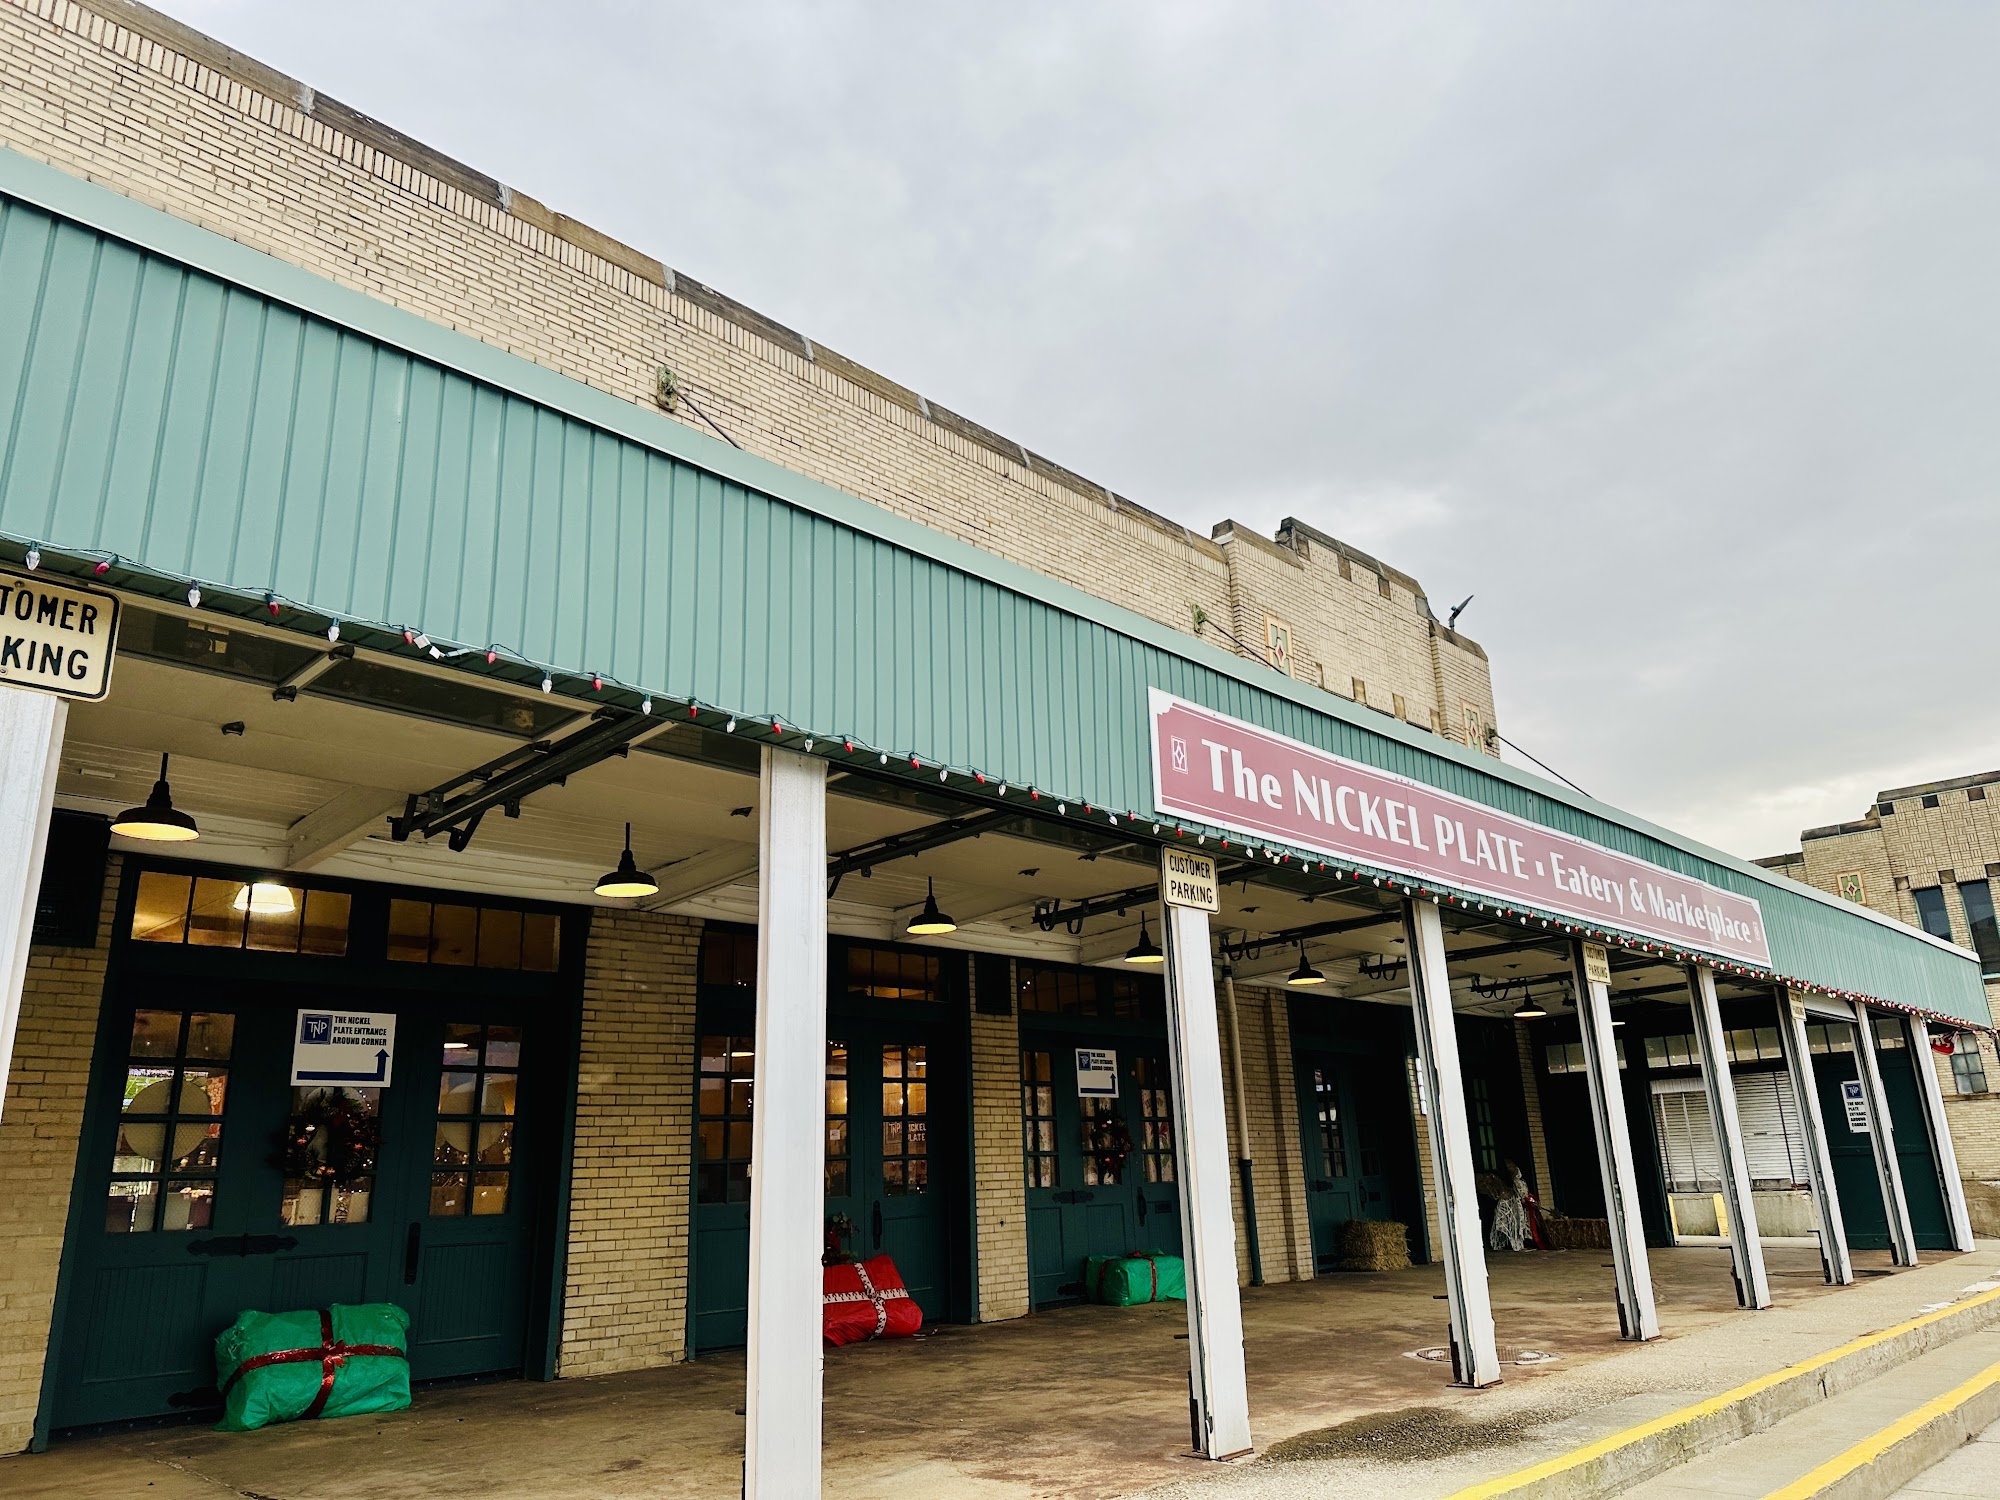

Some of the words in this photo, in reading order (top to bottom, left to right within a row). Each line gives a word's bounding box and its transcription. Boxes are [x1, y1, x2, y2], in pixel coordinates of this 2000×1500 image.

[1, 635, 89, 680] KING
[1201, 738, 1283, 810] The
[1292, 768, 1429, 852] NICKEL
[1433, 813, 1529, 881] PLATE
[1550, 851, 1624, 915] Eatery
[1628, 877, 1647, 914] &
[1646, 882, 1752, 944] Marketplace
[1169, 854, 1211, 880] CUSTOMER
[1170, 880, 1213, 904] PARKING
[307, 1020, 327, 1038] TNP
[334, 1015, 347, 1024] THE
[347, 1016, 371, 1025] NICKEL
[332, 1036, 360, 1045] AROUND
[360, 1037, 387, 1046] CORNER
[333, 1026, 353, 1035] PLATE
[353, 1026, 387, 1036] ENTRANCE
